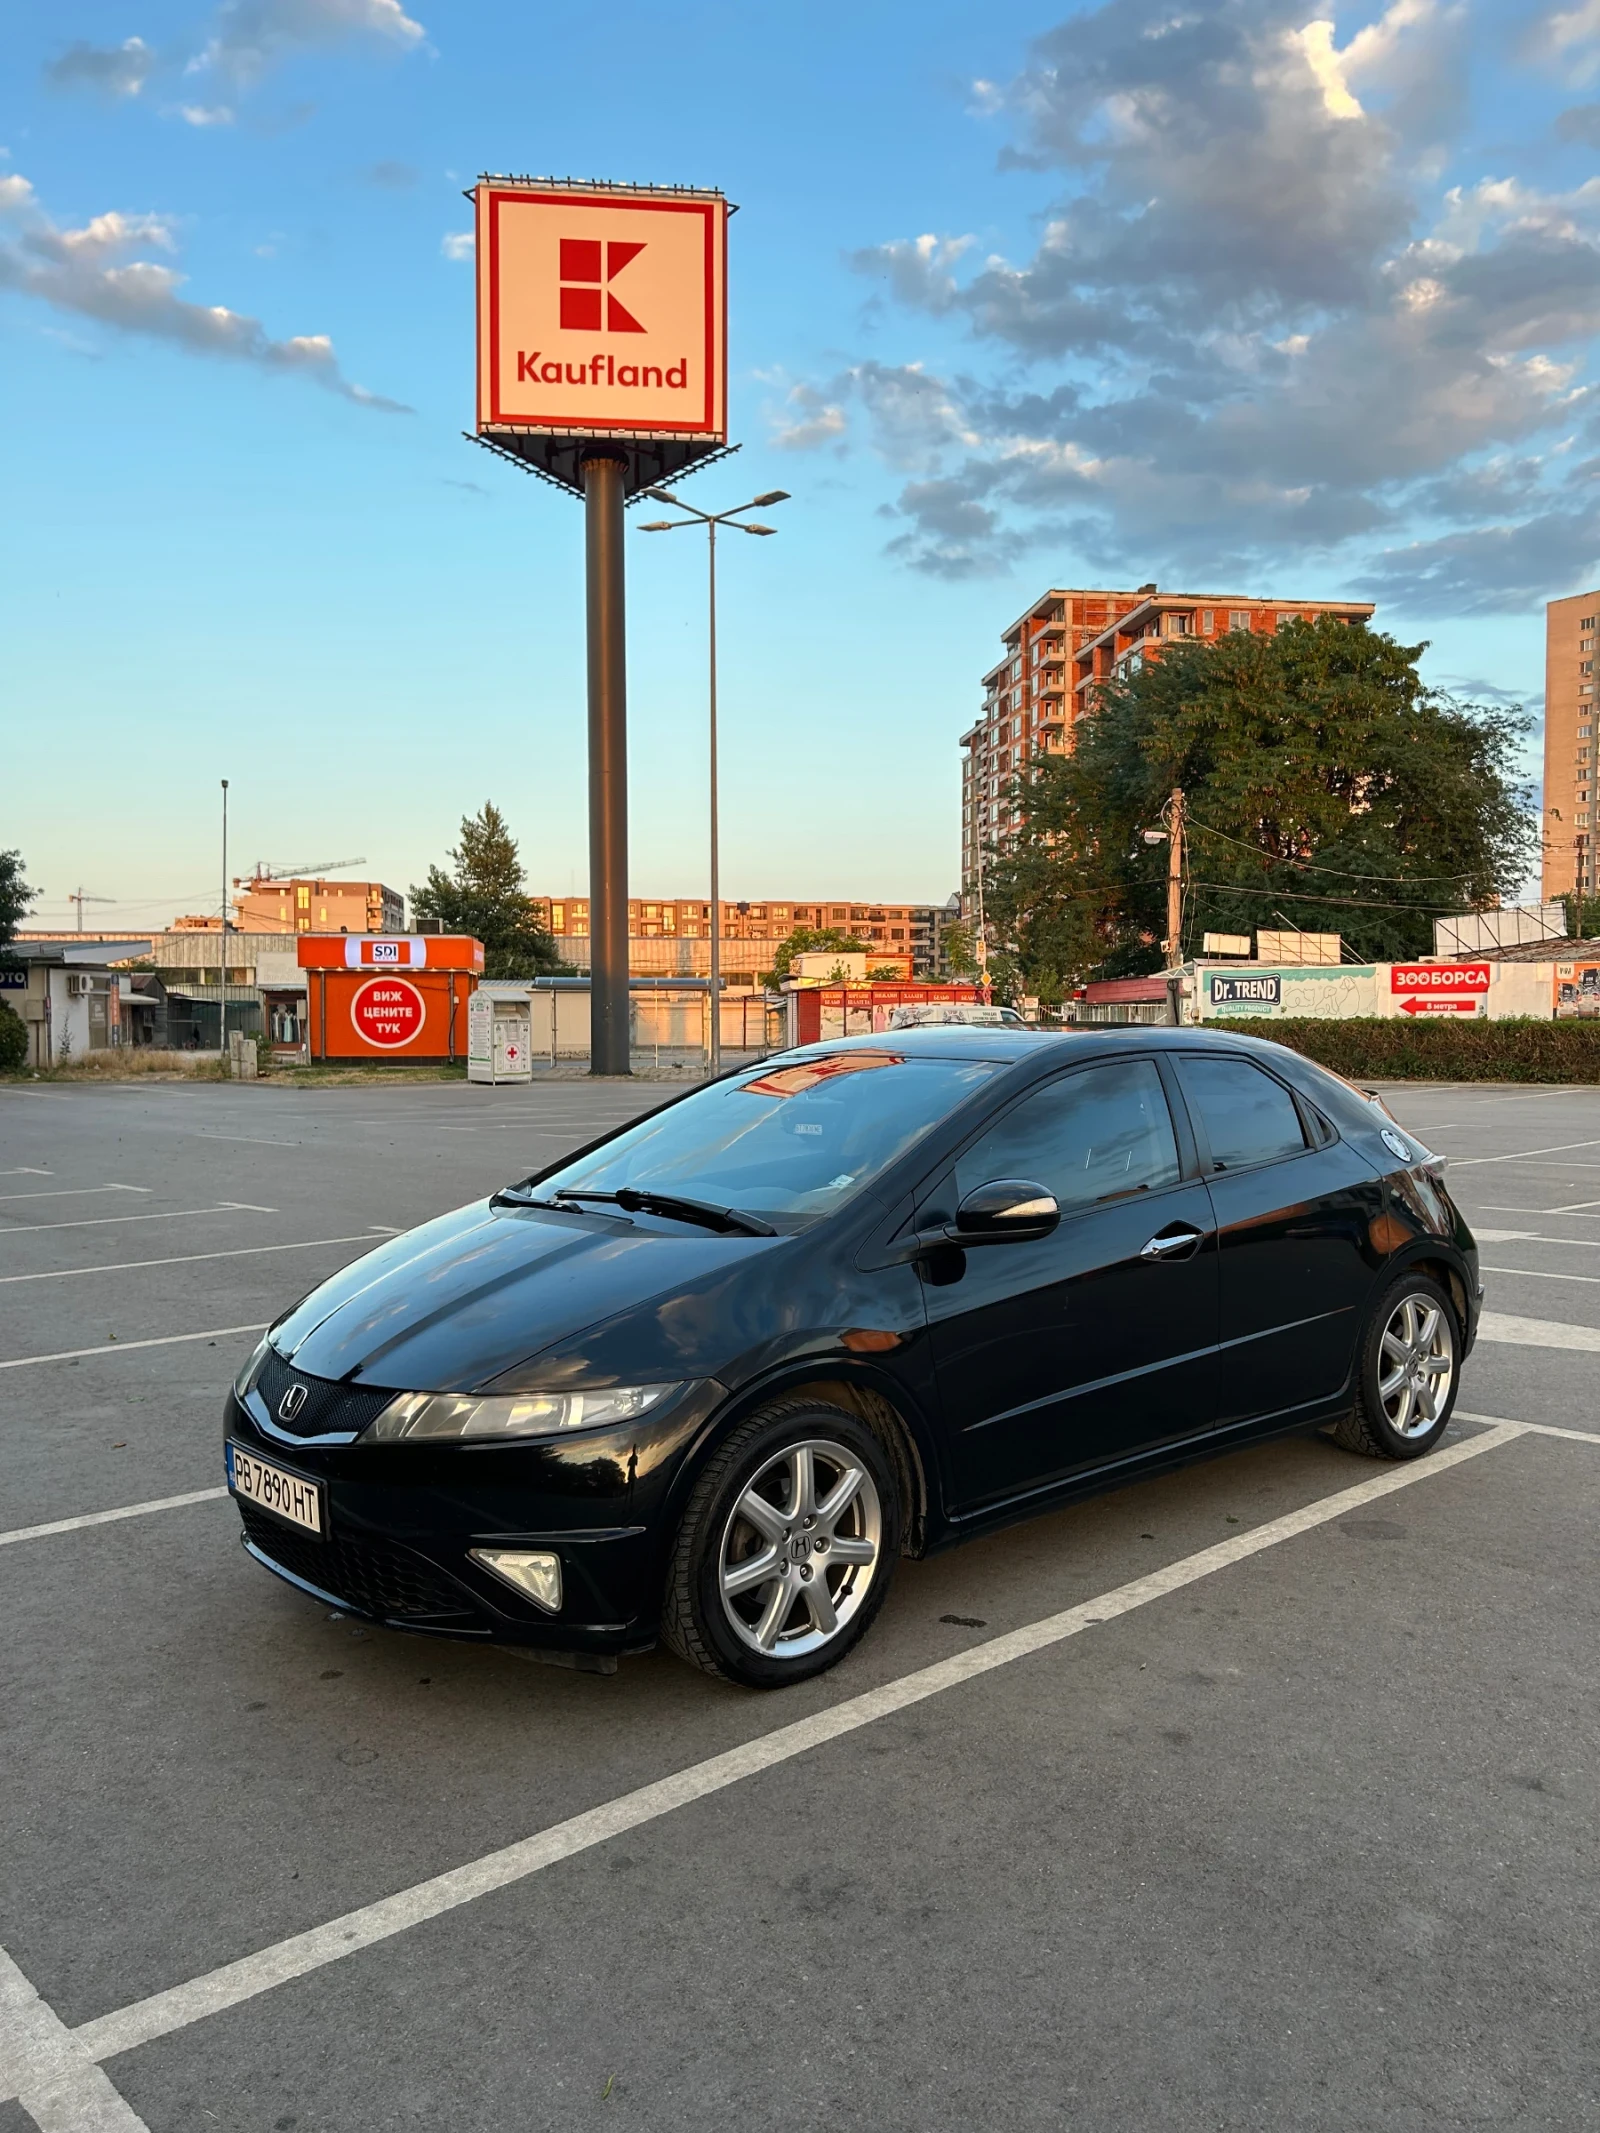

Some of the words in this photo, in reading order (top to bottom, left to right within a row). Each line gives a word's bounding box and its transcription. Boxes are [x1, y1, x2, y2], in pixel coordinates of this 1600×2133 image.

[518, 351, 687, 388] Kaufland
[375, 945, 397, 957] SDI
[1396, 971, 1488, 985] ЗООБОРСА
[1214, 979, 1233, 1000] Dr.
[1234, 978, 1276, 999] TREND
[373, 991, 403, 1001] ВИЖ
[1221, 1004, 1244, 1014] QUALITY
[1244, 1004, 1271, 1013] PRODUCT
[1433, 1003, 1457, 1011] метра
[363, 1007, 413, 1020] ЦЕНИТЕ
[376, 1023, 400, 1034] ТУК
